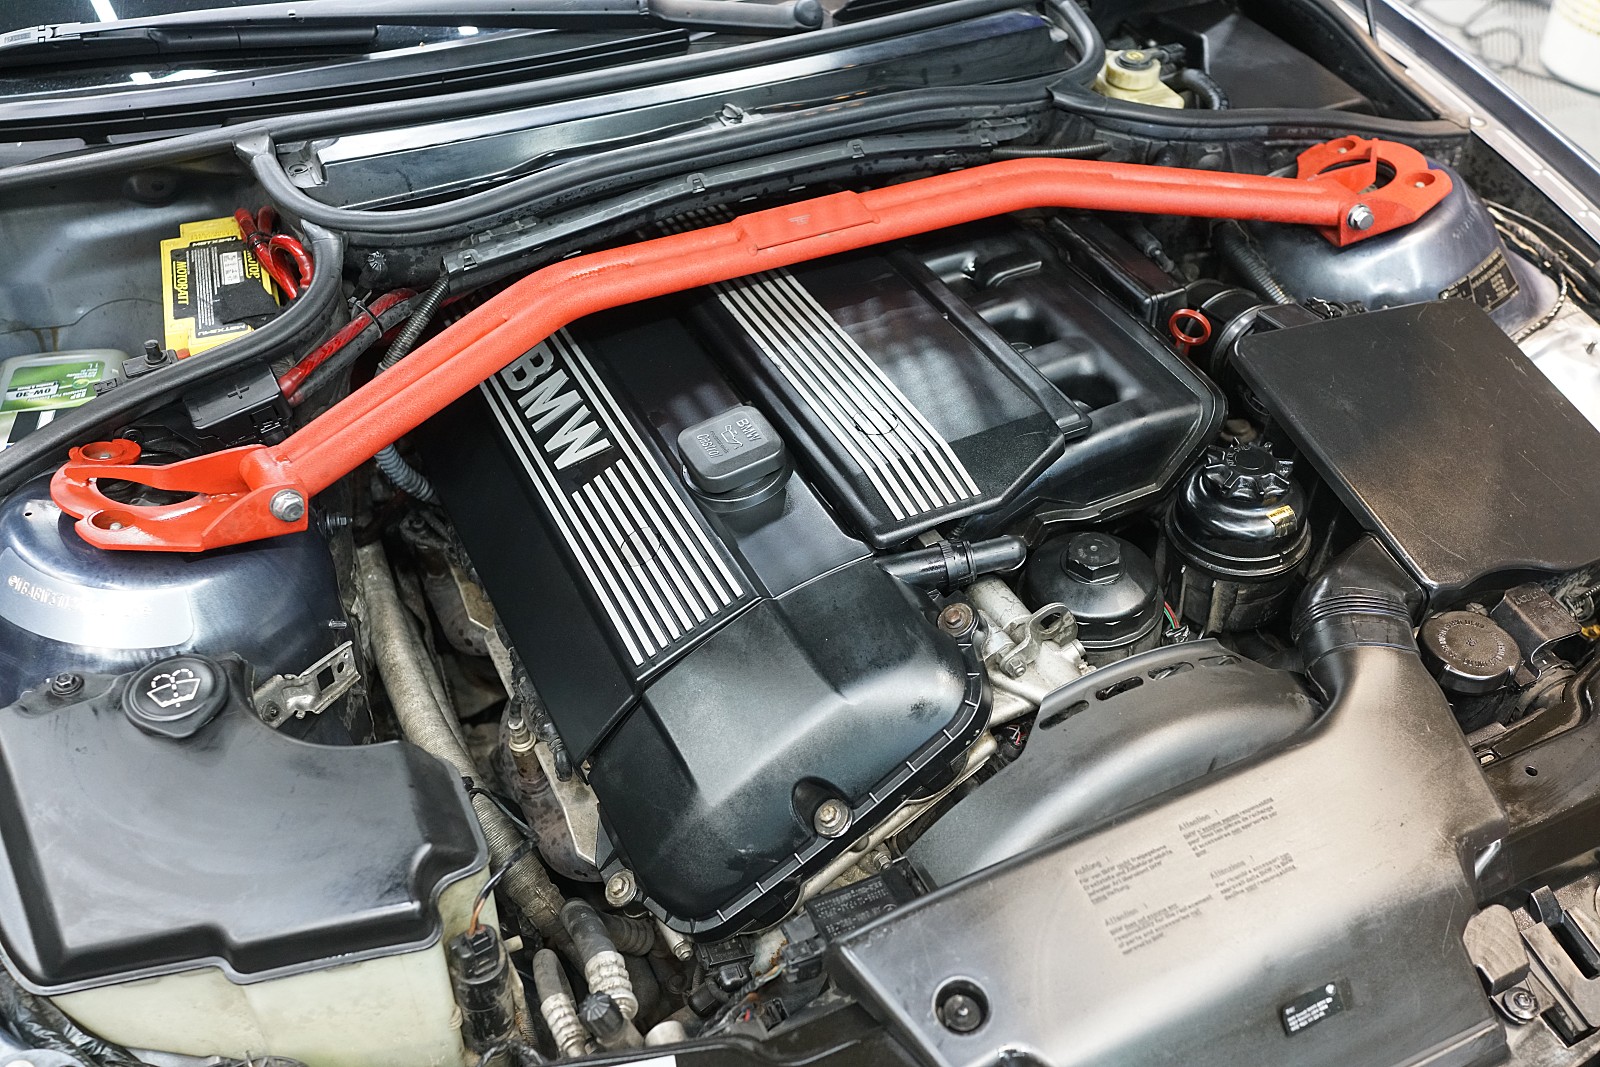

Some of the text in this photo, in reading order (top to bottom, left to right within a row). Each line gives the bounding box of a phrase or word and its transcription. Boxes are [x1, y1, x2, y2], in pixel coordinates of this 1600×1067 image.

[176, 261, 189, 305] MOTOBATT
[15, 388, 51, 398] 0W-30
[500, 341, 614, 470] BMW
[736, 418, 761, 441] BMW
[696, 433, 722, 459] Castrol
